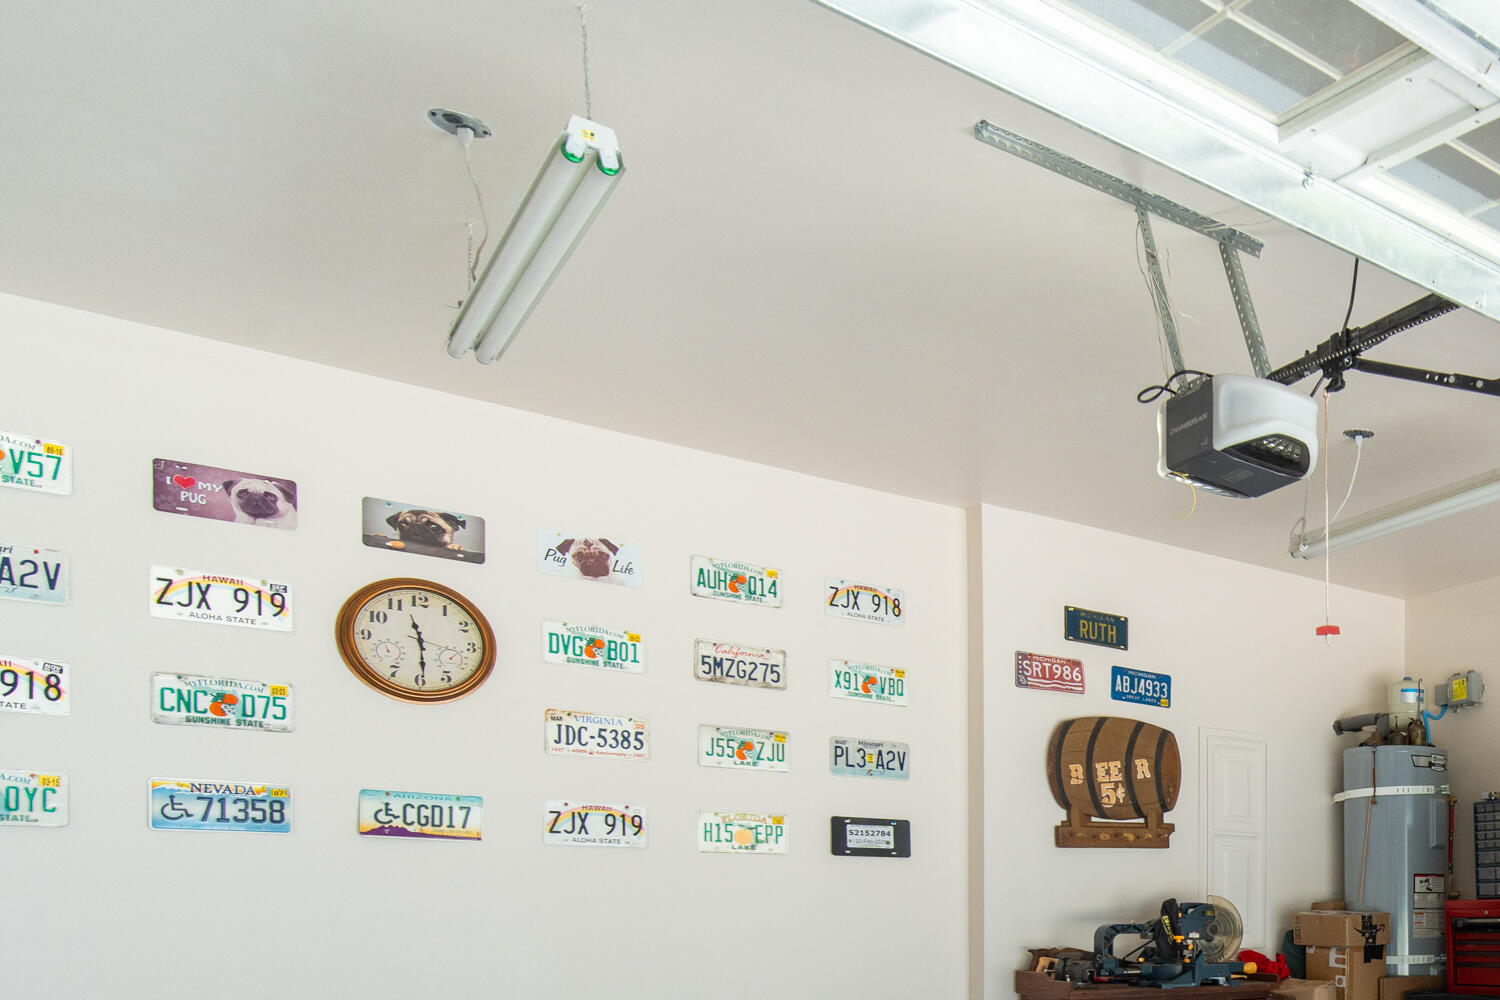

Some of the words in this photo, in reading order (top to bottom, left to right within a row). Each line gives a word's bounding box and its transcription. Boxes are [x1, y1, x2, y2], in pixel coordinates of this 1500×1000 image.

[9, 447, 62, 480] V57
[1, 474, 35, 487] STATE
[197, 481, 224, 493] MY
[180, 491, 207, 505] PUG
[544, 548, 567, 567] Pug
[0, 556, 61, 590] A2V
[612, 560, 634, 575] Life
[202, 574, 244, 586] HAWAII
[697, 568, 727, 591] AUH
[156, 577, 212, 611] ZJX
[233, 587, 286, 617] 919
[387, 597, 403, 611] 11
[411, 595, 430, 608] 12
[713, 591, 741, 600] SUNSHINE
[745, 595, 763, 603] STATE
[829, 586, 860, 611] ZJX
[872, 594, 901, 617] 918
[369, 610, 388, 624] 10
[441, 604, 448, 616] 1
[1080, 611, 1115, 623] MICHIGAN
[189, 611, 223, 621] ALOHA
[226, 616, 256, 625] STATE
[458, 620, 470, 633] 2
[1080, 619, 1117, 644] RUTH
[360, 628, 372, 640] 9
[466, 642, 477, 653] 3
[548, 632, 583, 657] DVG
[715, 645, 768, 660] California
[1033, 655, 1066, 664] MICHIGAN
[566, 657, 600, 667] SUNSHINE
[603, 661, 624, 669] STATE
[701, 655, 780, 683] 5MZG275
[390, 664, 401, 677] 7
[440, 671, 452, 683] 5
[1022, 660, 1082, 682] SRT986
[1128, 670, 1156, 679] MICHIGAN
[0, 669, 62, 701] 918
[414, 674, 426, 687] 6
[835, 670, 859, 691] X91
[1115, 675, 1168, 698] ABJ4933
[160, 687, 208, 714] CNC
[241, 694, 286, 720] D75
[185, 715, 231, 726] SUNSHINE
[235, 719, 263, 728] STATE
[574, 715, 624, 727] VIRGINIA
[554, 724, 645, 750] JDC-5385
[706, 738, 735, 758] J55
[834, 746, 866, 768] PL3
[876, 750, 906, 771] A2V
[189, 782, 257, 795] NEVADA
[196, 796, 285, 824] 71358
[402, 803, 471, 829] CGD17
[549, 811, 589, 835] ZJX
[605, 813, 643, 836] 919
[704, 823, 733, 843] H15
[755, 825, 783, 844] EPP
